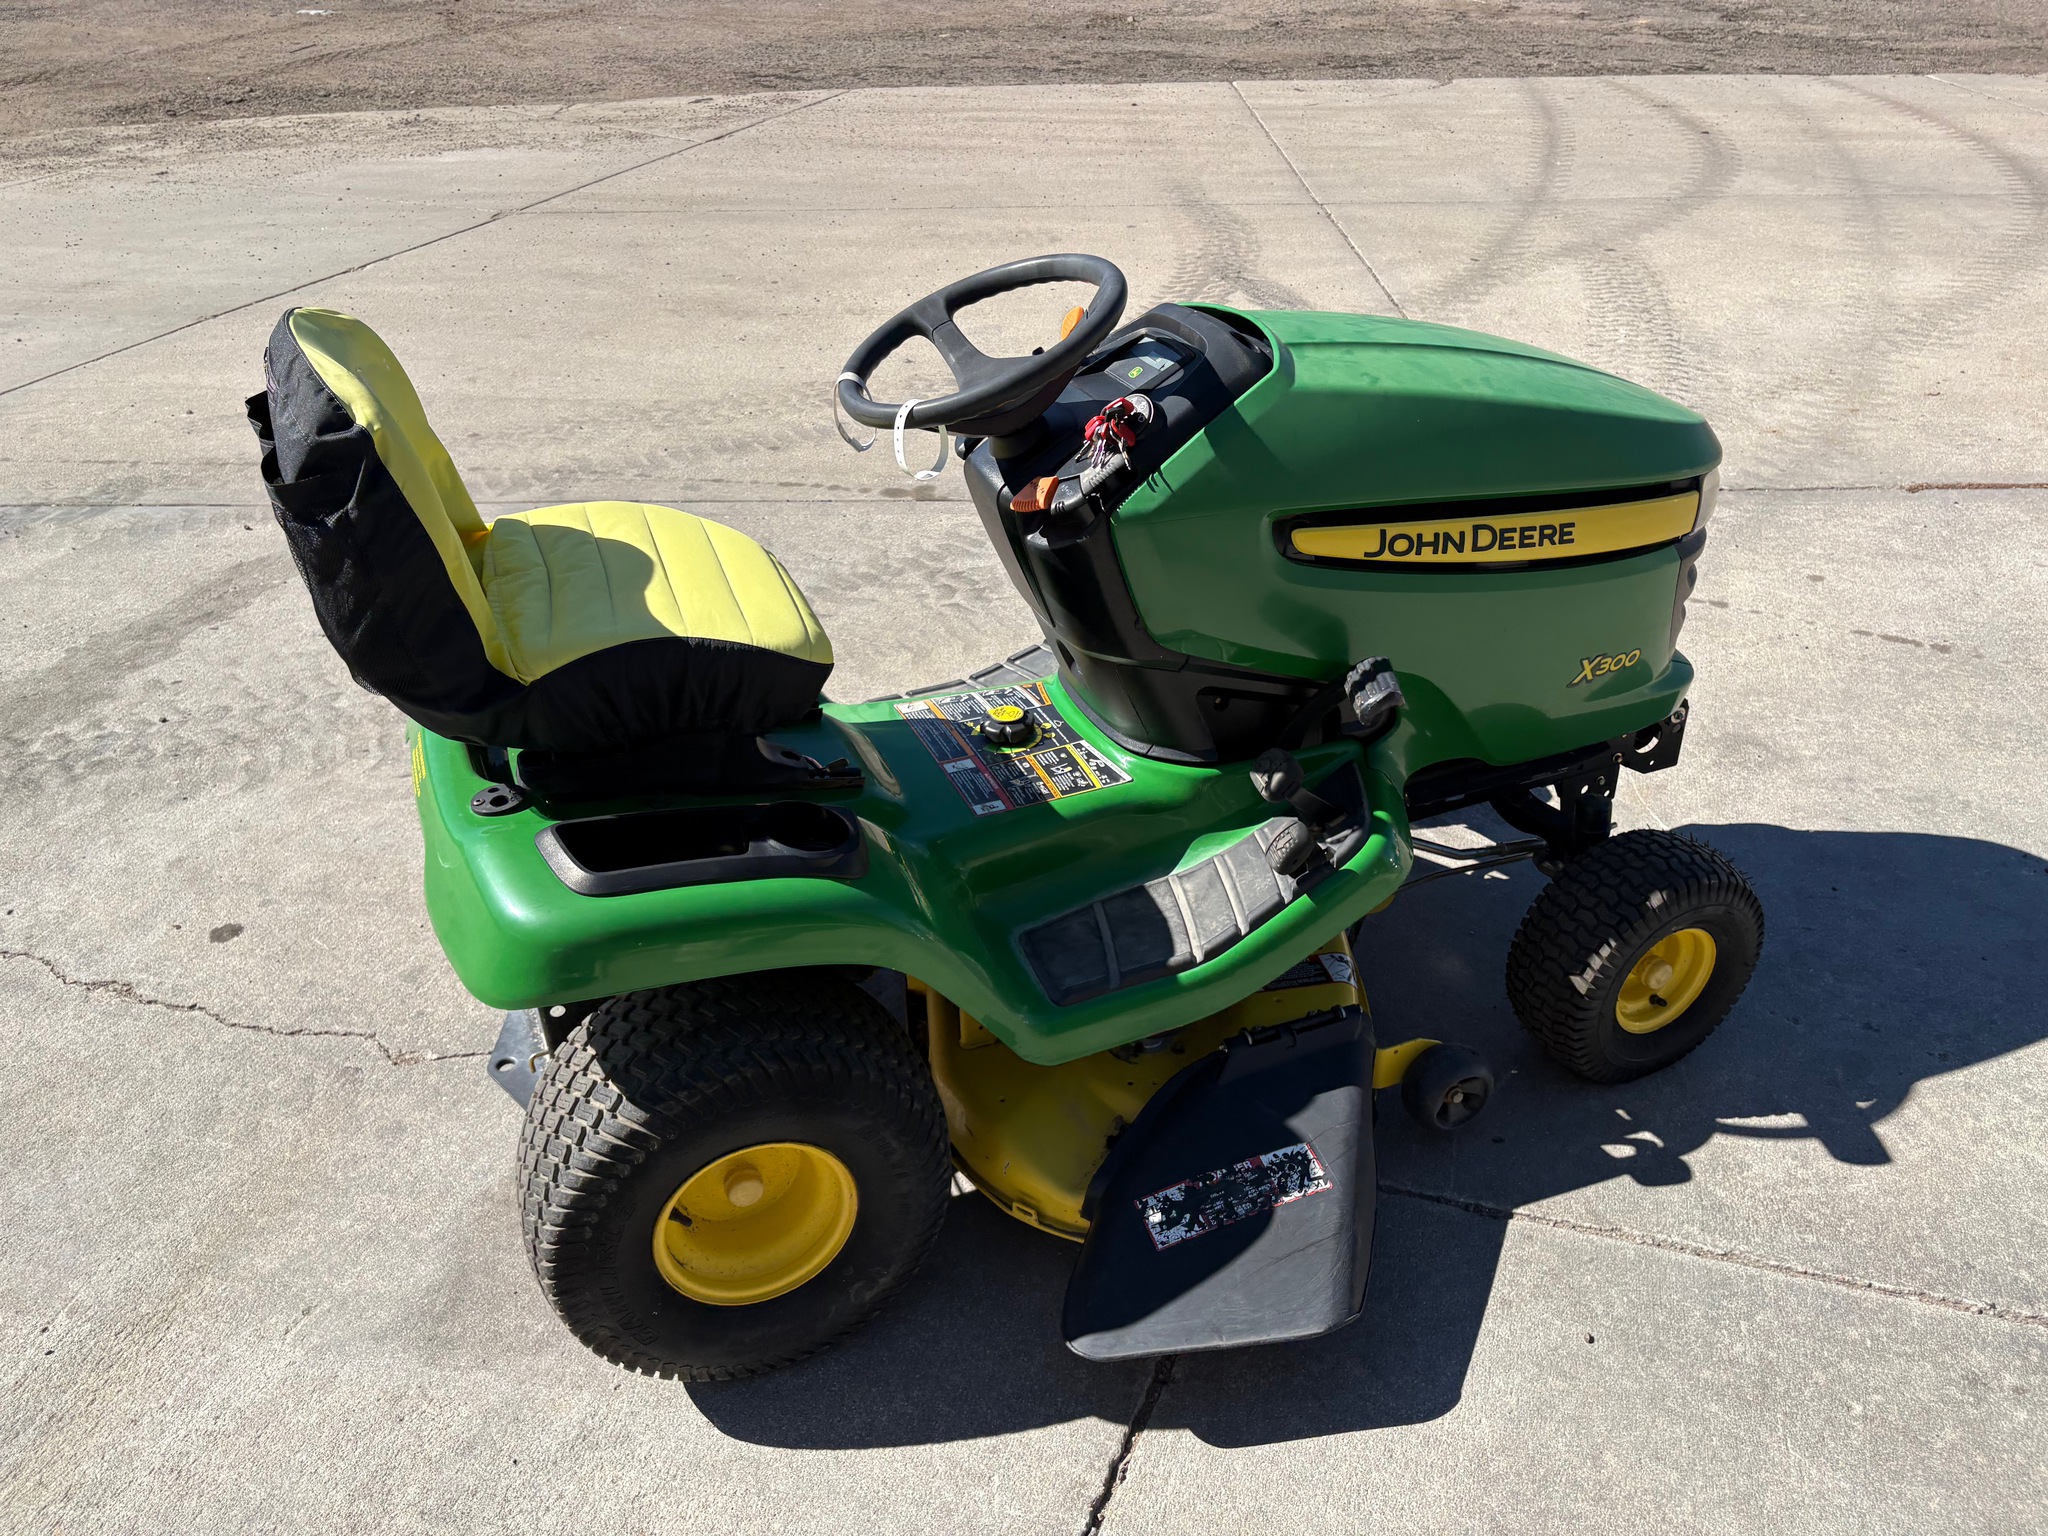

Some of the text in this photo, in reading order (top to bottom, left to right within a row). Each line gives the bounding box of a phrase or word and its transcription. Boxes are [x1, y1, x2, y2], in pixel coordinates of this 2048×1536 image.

[1364, 522, 1576, 558] JOHN DEERE
[1566, 648, 1641, 688] X300
